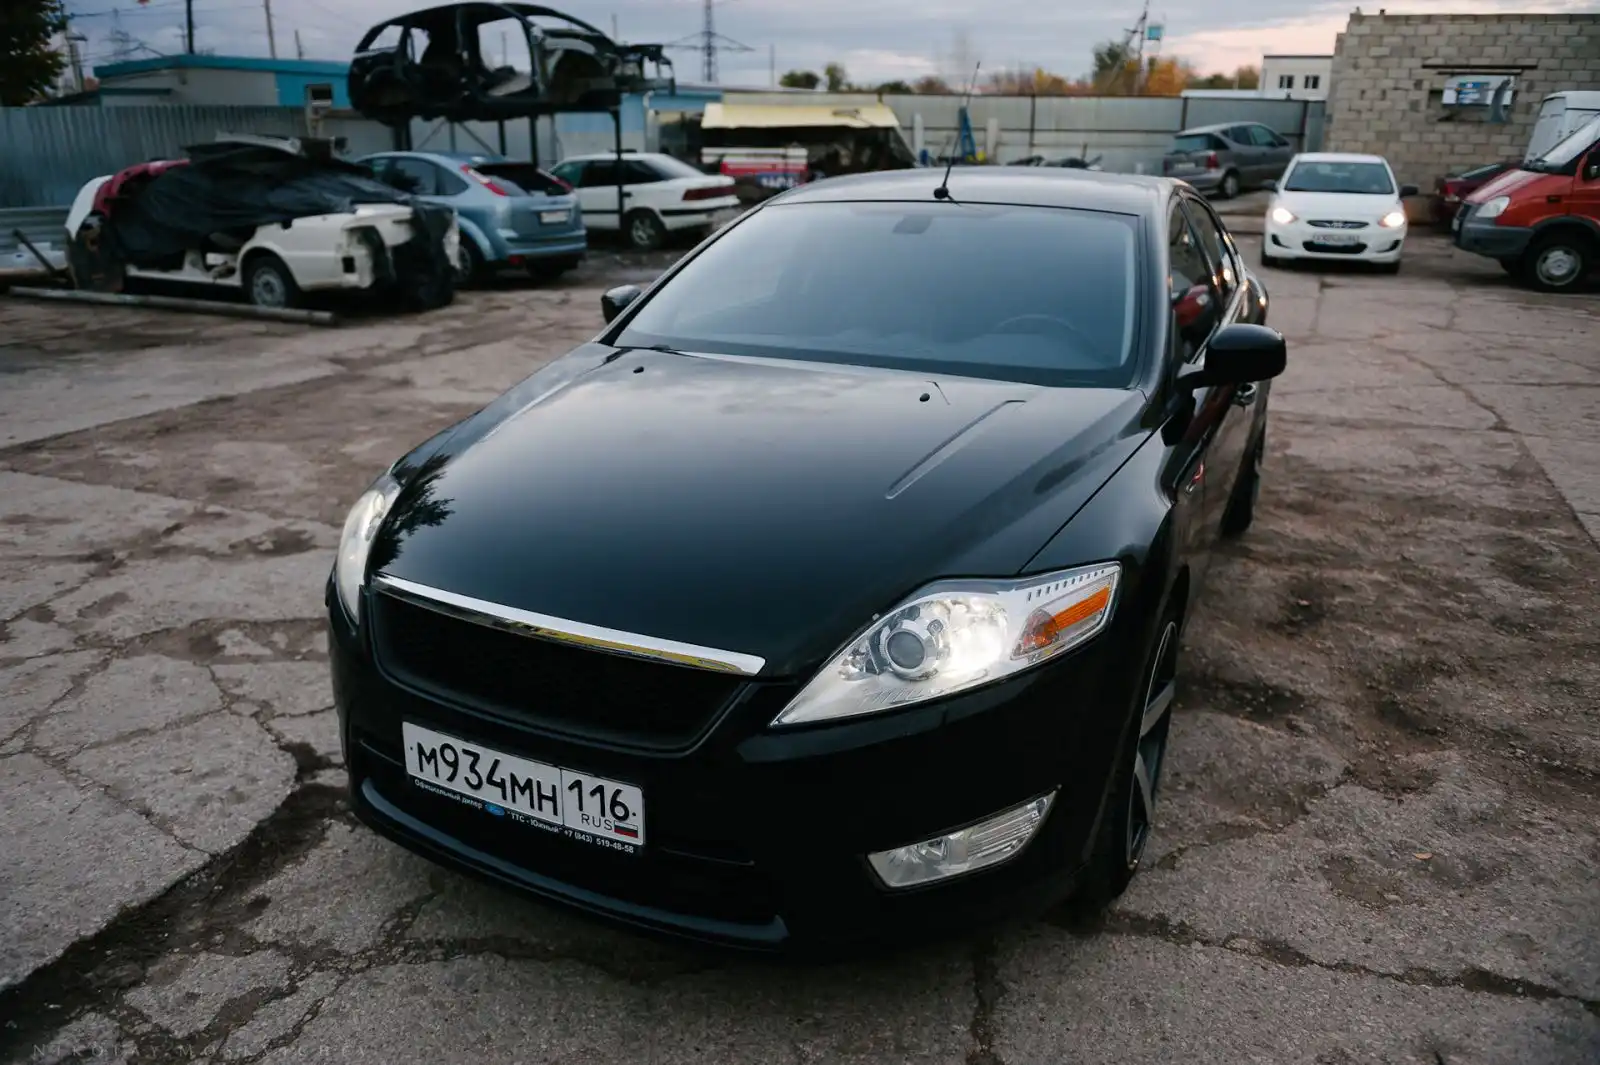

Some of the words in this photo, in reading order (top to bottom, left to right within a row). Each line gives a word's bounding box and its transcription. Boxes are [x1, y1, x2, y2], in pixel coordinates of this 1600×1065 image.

[417, 742, 558, 816] М934МН
[568, 779, 630, 822] 116
[581, 813, 613, 831] RUS
[574, 832, 593, 844] (843)
[595, 838, 634, 854] 519-48-58
